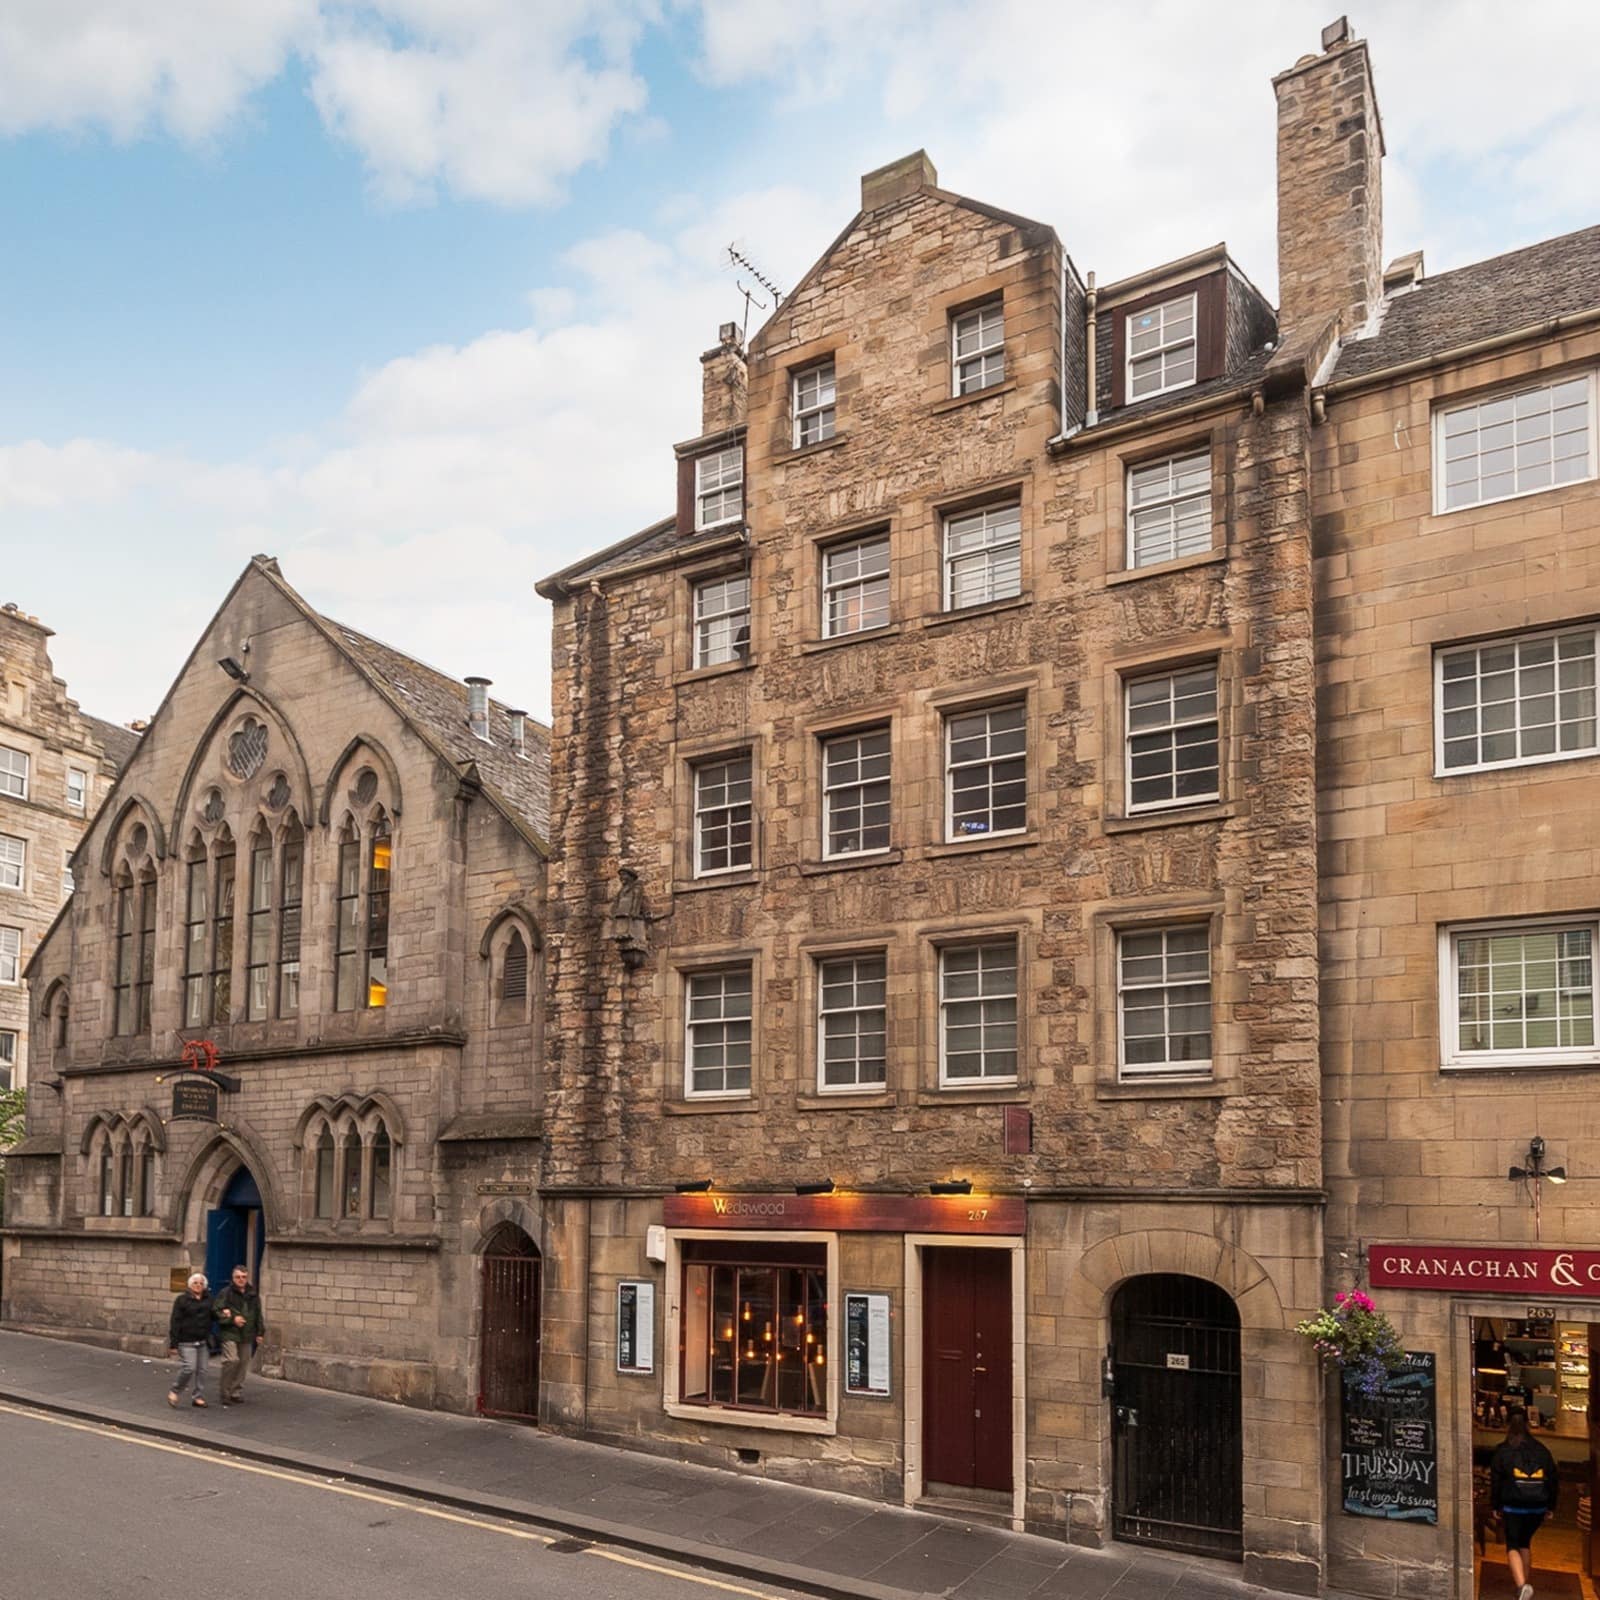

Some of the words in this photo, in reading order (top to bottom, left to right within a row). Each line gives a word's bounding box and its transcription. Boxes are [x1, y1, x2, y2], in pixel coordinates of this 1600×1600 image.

[713, 1198, 785, 1216] Wedgwood
[967, 1210, 988, 1221] 267
[1383, 1257, 1539, 1279] CRANACHAN
[1549, 1253, 1584, 1287] &
[1528, 1308, 1555, 1319] 263
[1171, 1357, 1185, 1366] 265
[1341, 1453, 1435, 1484] THURSDAY
